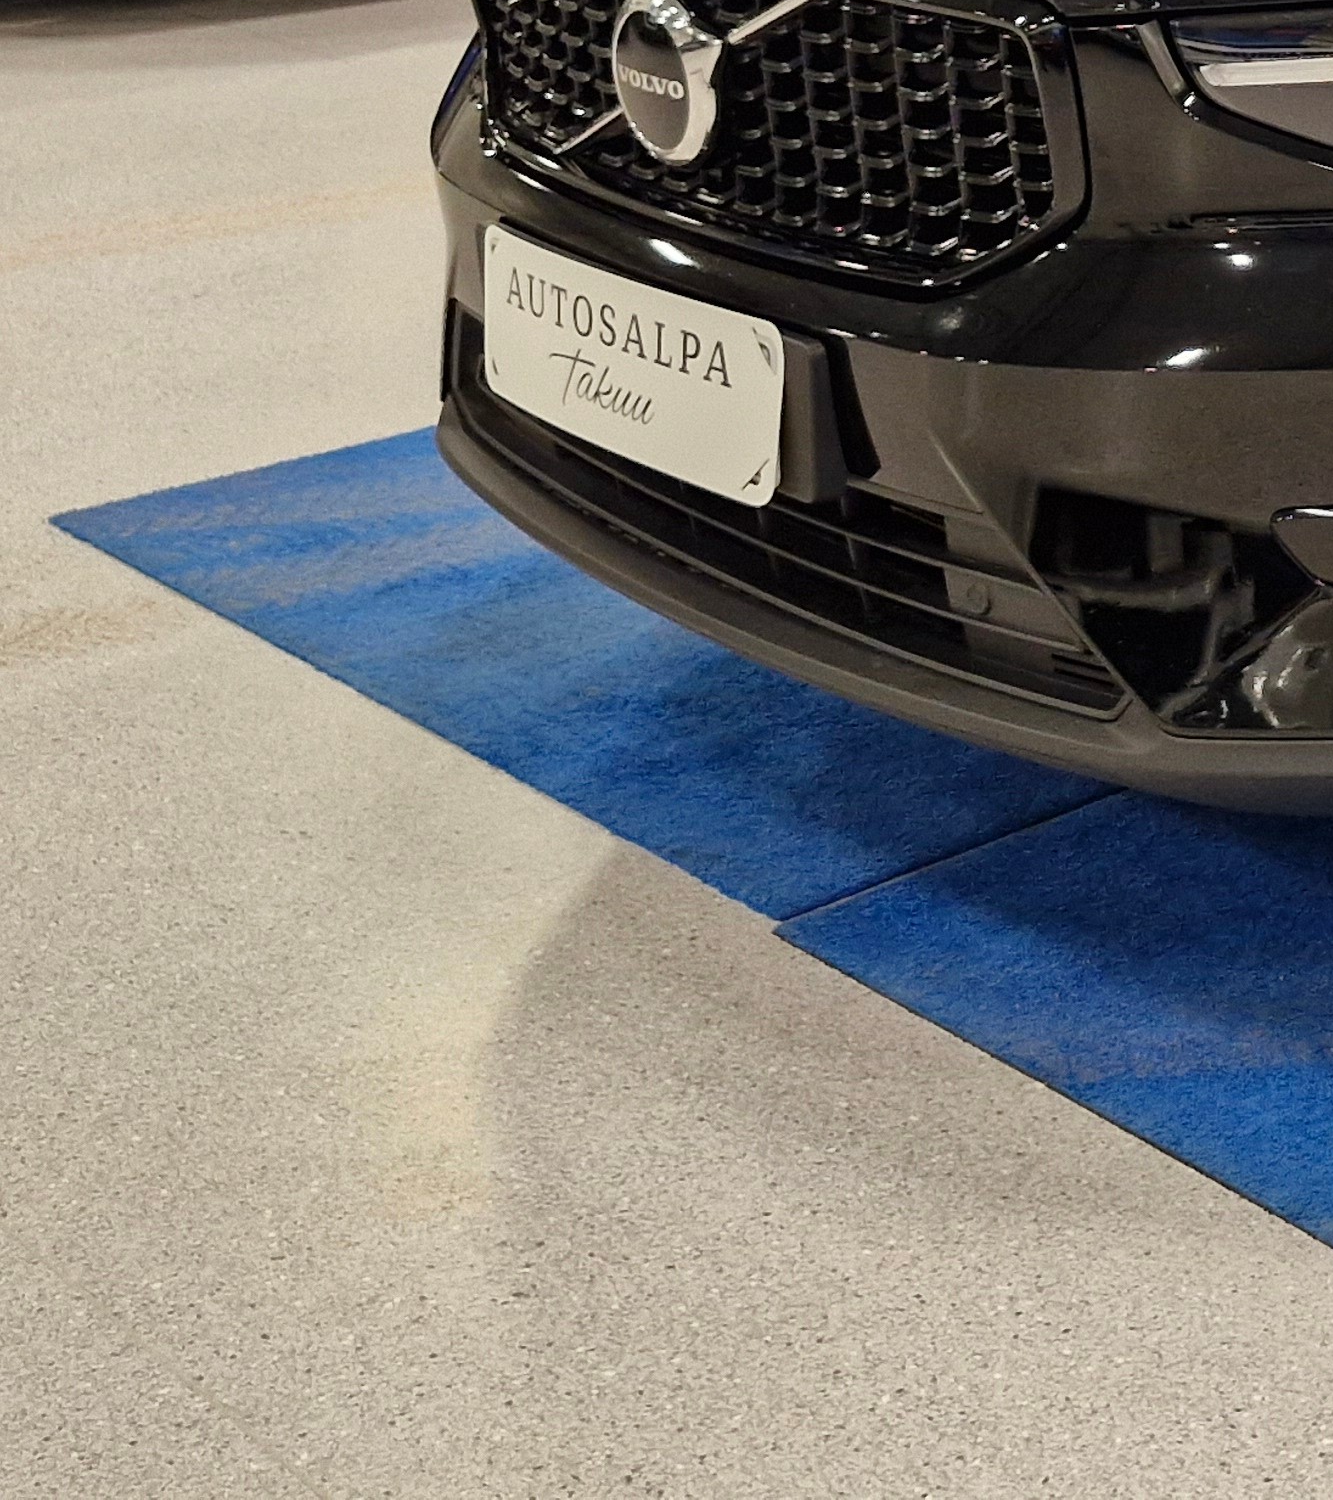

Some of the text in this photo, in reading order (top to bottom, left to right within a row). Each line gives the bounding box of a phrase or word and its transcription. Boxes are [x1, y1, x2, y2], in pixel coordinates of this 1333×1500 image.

[617, 63, 685, 100] VOLVO
[506, 267, 732, 388] AUTOSALPA
[549, 349, 655, 425] Takuu
